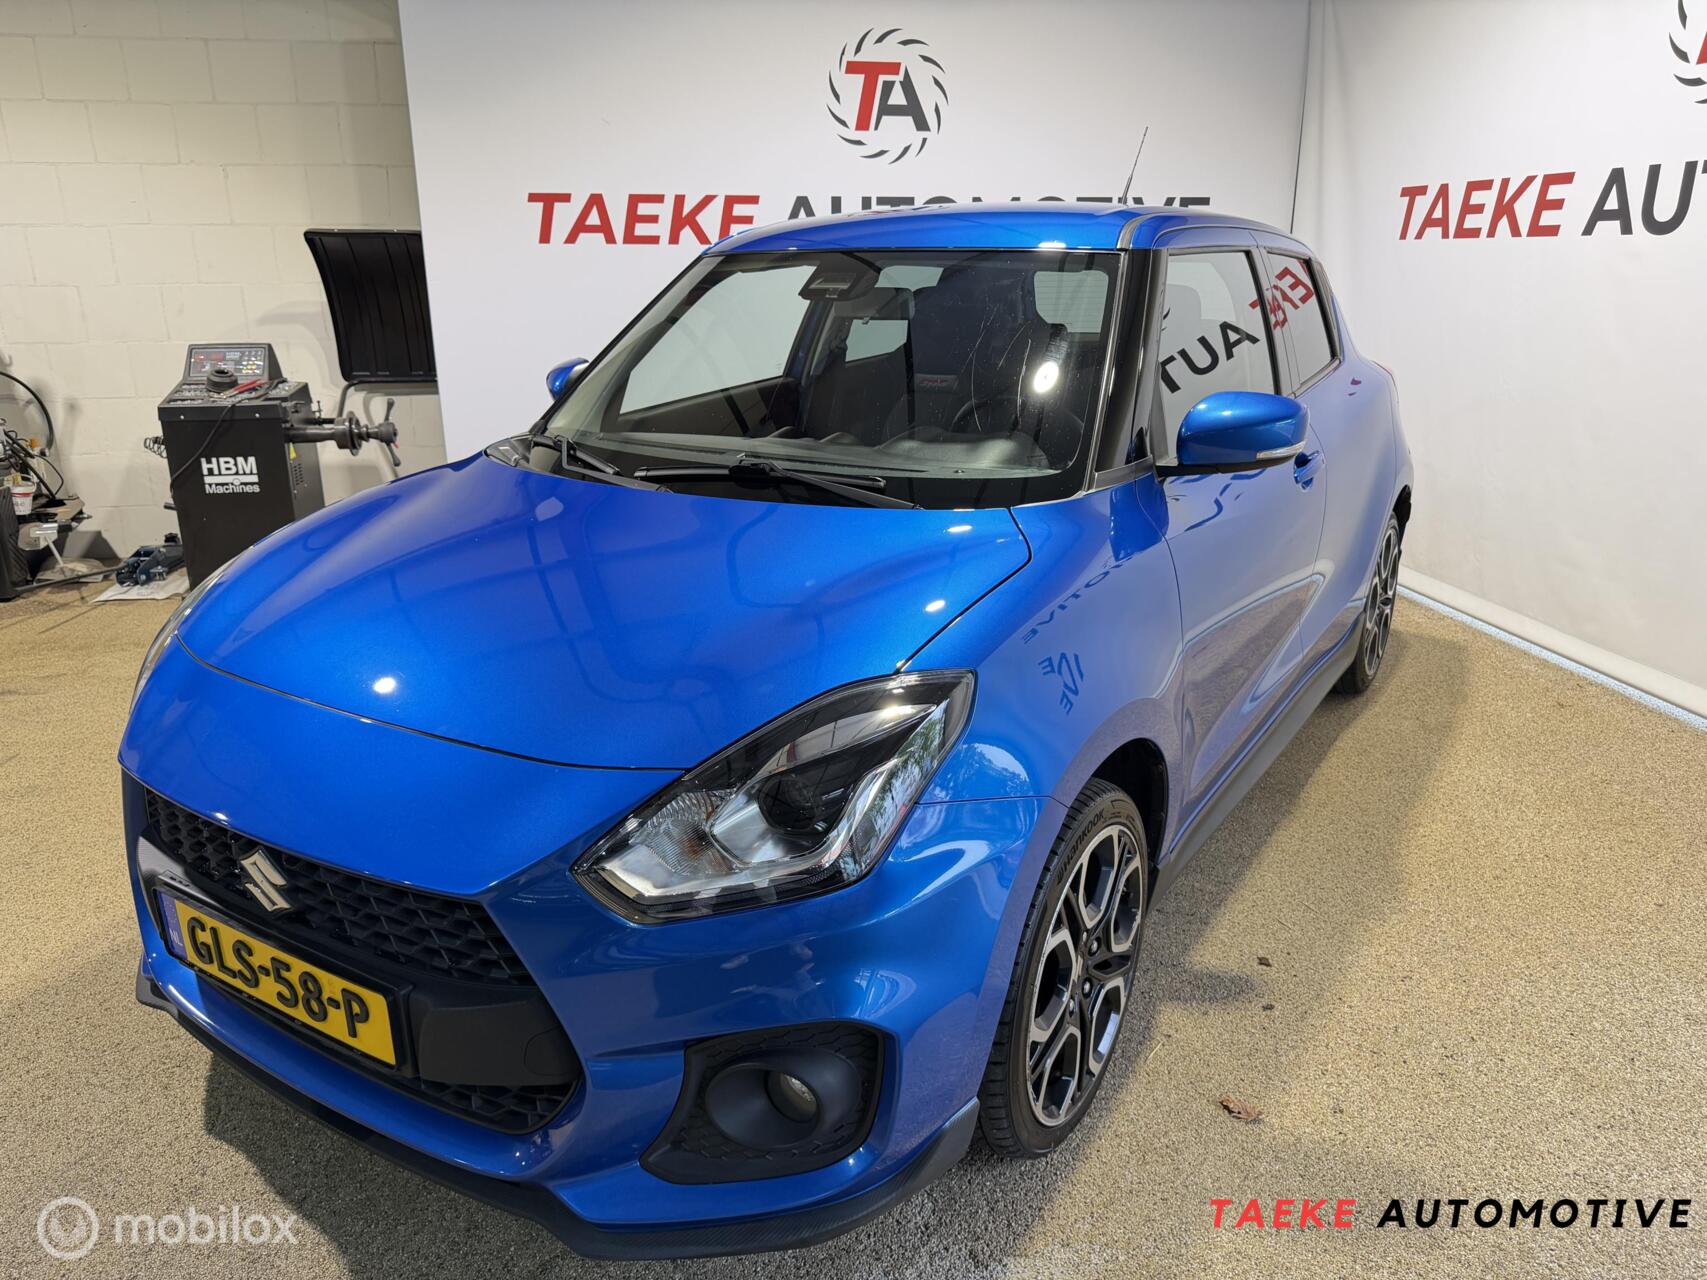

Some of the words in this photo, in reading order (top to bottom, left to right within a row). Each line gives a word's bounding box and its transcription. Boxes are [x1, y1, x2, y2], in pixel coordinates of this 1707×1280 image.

[845, 60, 931, 132] TA
[1399, 171, 1576, 240] TAEKE
[1580, 159, 1707, 236] AU
[201, 456, 258, 475] HBM
[205, 481, 260, 494] Machines
[169, 927, 183, 946] NL
[187, 916, 370, 1038] GLS-58-P
